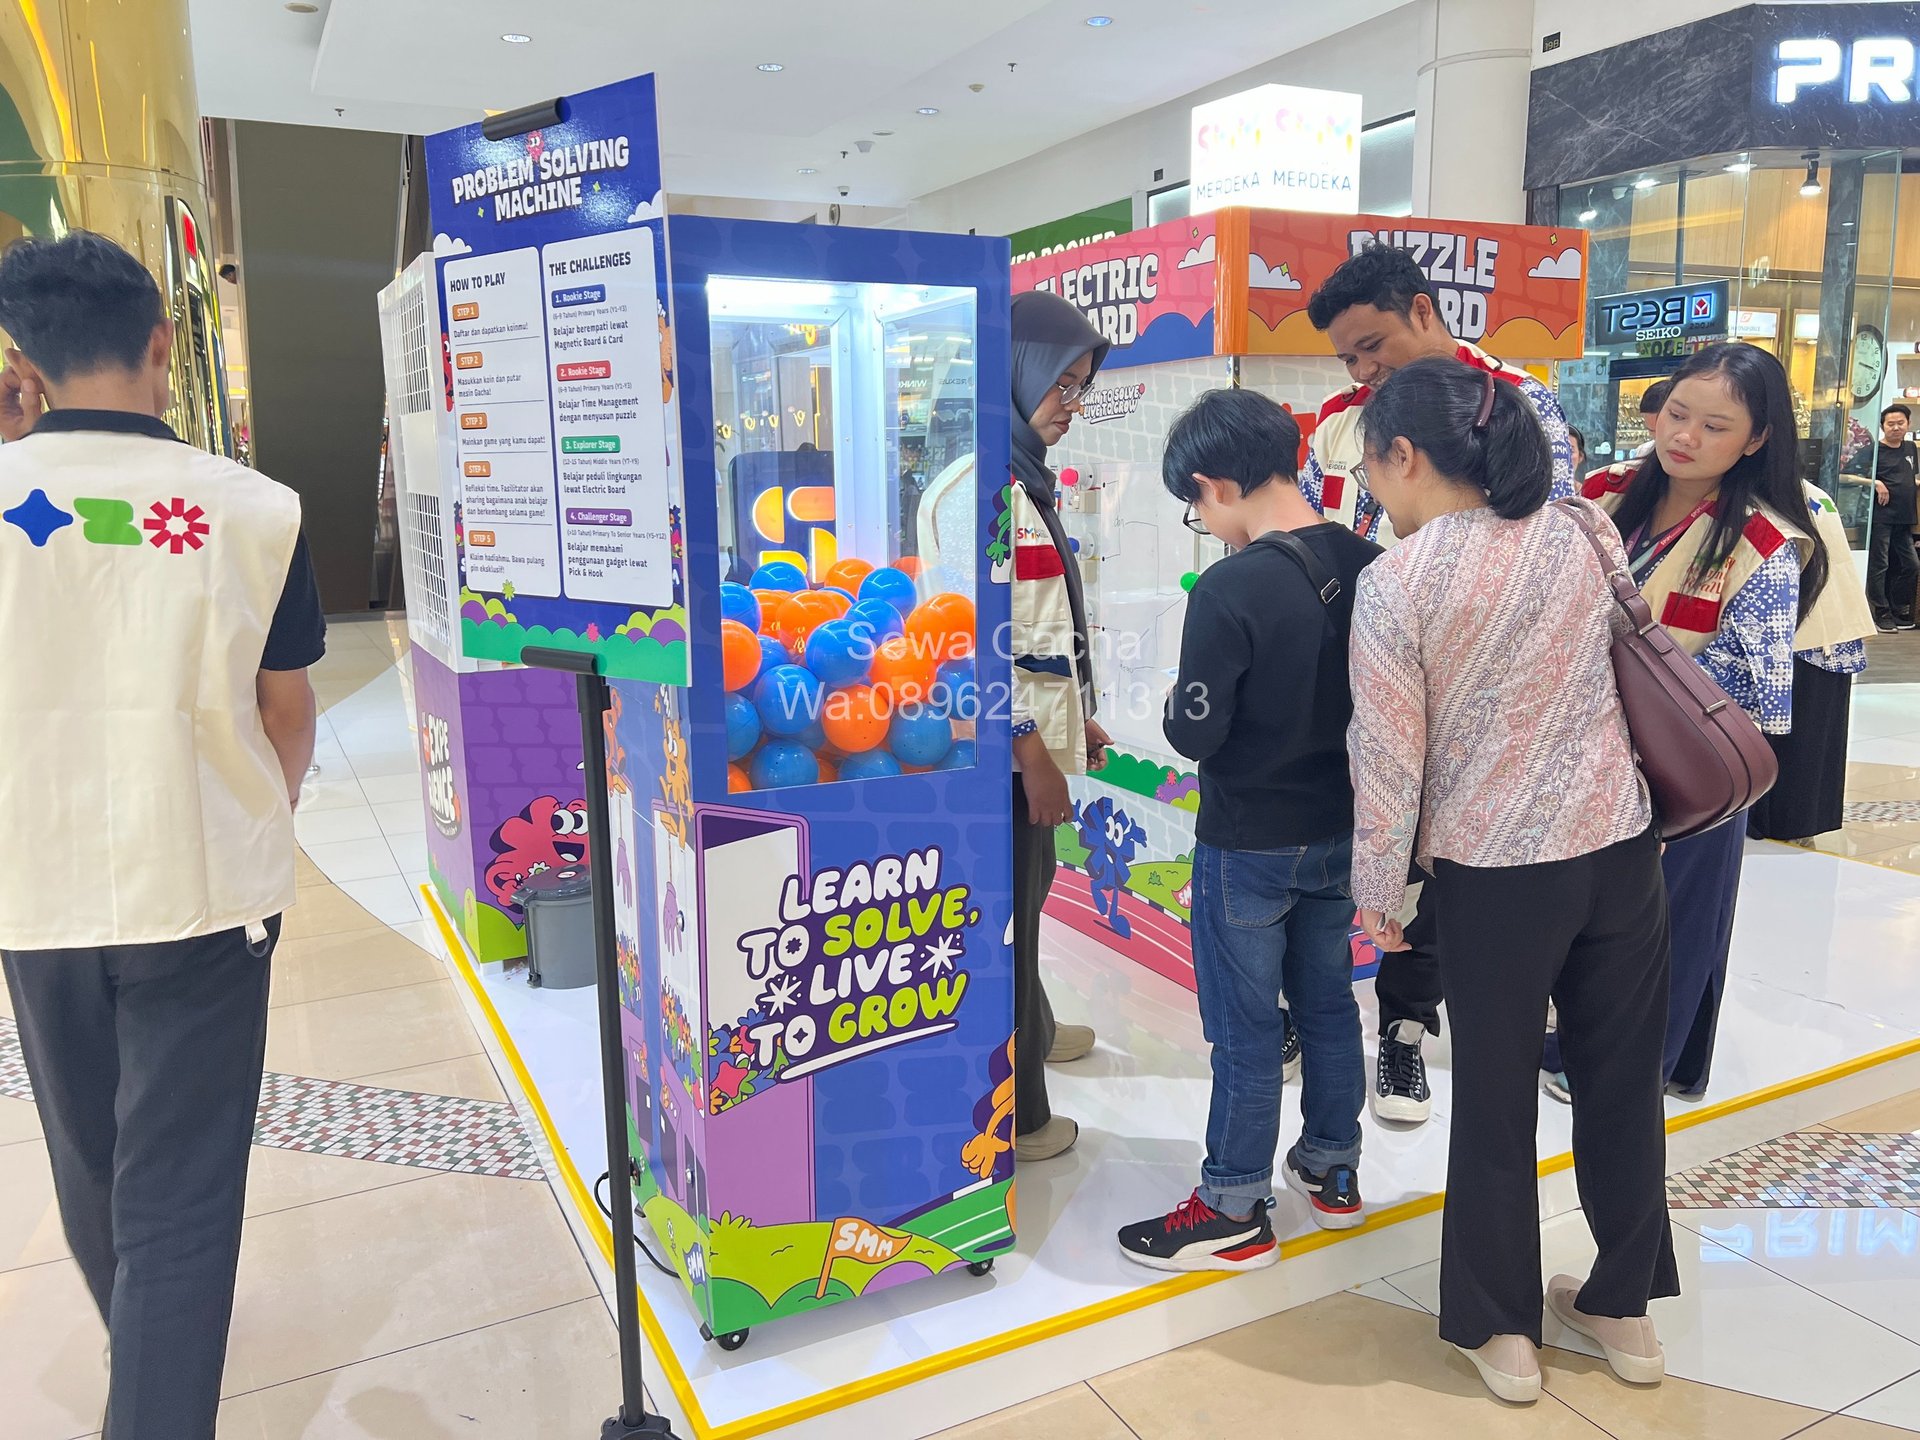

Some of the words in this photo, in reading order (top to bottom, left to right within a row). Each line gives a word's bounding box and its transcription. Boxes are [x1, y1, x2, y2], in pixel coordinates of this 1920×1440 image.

[1776, 39, 1914, 103] PR
[452, 157, 534, 204] PROBLEM
[540, 136, 629, 180] SOLVING
[1197, 172, 1259, 200] MERDEKA
[1274, 170, 1351, 191] MERDEKA
[495, 177, 582, 221] MACHINE
[549, 262, 567, 276] THE
[570, 251, 631, 273] CHALLENGES
[450, 278, 469, 292] HOW
[472, 276, 482, 290] TO
[485, 272, 505, 287] PLAY
[1034, 254, 1158, 308] ECTRIC
[563, 291, 582, 302] Rookie
[584, 290, 601, 301] Stage
[457, 307, 470, 317] STEP
[470, 307, 474, 315] 1
[454, 329, 470, 338] Daftar
[471, 328, 480, 336] dan
[482, 325, 505, 337] dapatkan
[507, 322, 528, 332] koinmu!
[554, 326, 575, 336] Belajar
[577, 323, 608, 333] berempati
[610, 321, 628, 330] lewat
[1086, 302, 1138, 345] ARD
[1636, 326, 1682, 341] SEIKO
[555, 338, 582, 350] Magnetic
[584, 336, 601, 346] Board
[602, 336, 607, 344] &
[609, 334, 623, 343] Card
[461, 357, 473, 365] STEP
[568, 366, 587, 376] Rookie
[589, 365, 606, 376] Stage
[458, 377, 482, 385] Masukkan
[484, 375, 494, 384] koin
[507, 374, 521, 384] putar
[474, 388, 491, 397] Gacha!
[583, 385, 600, 393] Primary
[559, 400, 580, 410] Belajar
[581, 399, 596, 408] Time
[598, 398, 638, 408] Management
[1080, 391, 1100, 406] ARN
[1101, 389, 1112, 402] TO
[1083, 404, 1101, 419] LIVE
[1101, 402, 1112, 416] TO
[1114, 400, 1138, 414] GROW
[560, 413, 581, 422] dengan
[583, 413, 614, 422] menyusun
[616, 411, 636, 420] puzzle
[484, 439, 497, 447] game
[499, 438, 511, 446] yang
[512, 436, 526, 444] kamu
[528, 436, 545, 445] dapat!
[566, 441, 572, 449] 3.
[573, 440, 597, 449] Explorer
[598, 440, 615, 450] Stage
[563, 472, 584, 481] Belajar
[586, 472, 605, 481] peduli
[607, 472, 642, 483] lingkungan
[465, 484, 485, 492] Refleksi
[501, 484, 529, 492] Fasilitator
[466, 496, 485, 505] sharing
[486, 496, 513, 505] bagaimana
[529, 497, 548, 507] belajar
[478, 508, 508, 518] berkembang
[529, 509, 545, 519] game!
[578, 512, 608, 522] Challenger
[610, 514, 627, 523] Stage
[567, 543, 588, 552] Belajar
[590, 544, 623, 553] memahami
[526, 556, 544, 566] pulang
[568, 557, 604, 565] penggunaan
[606, 558, 627, 567] gadget
[629, 559, 647, 567] lewat
[588, 569, 603, 577] Hook
[783, 848, 939, 921] LEARN
[741, 924, 810, 976] TO
[823, 887, 978, 957] SOLVE,
[810, 943, 915, 1005] LIVE
[750, 1014, 816, 1066] TO
[828, 973, 967, 1044] GROW
[835, 1222, 893, 1258] SMM
